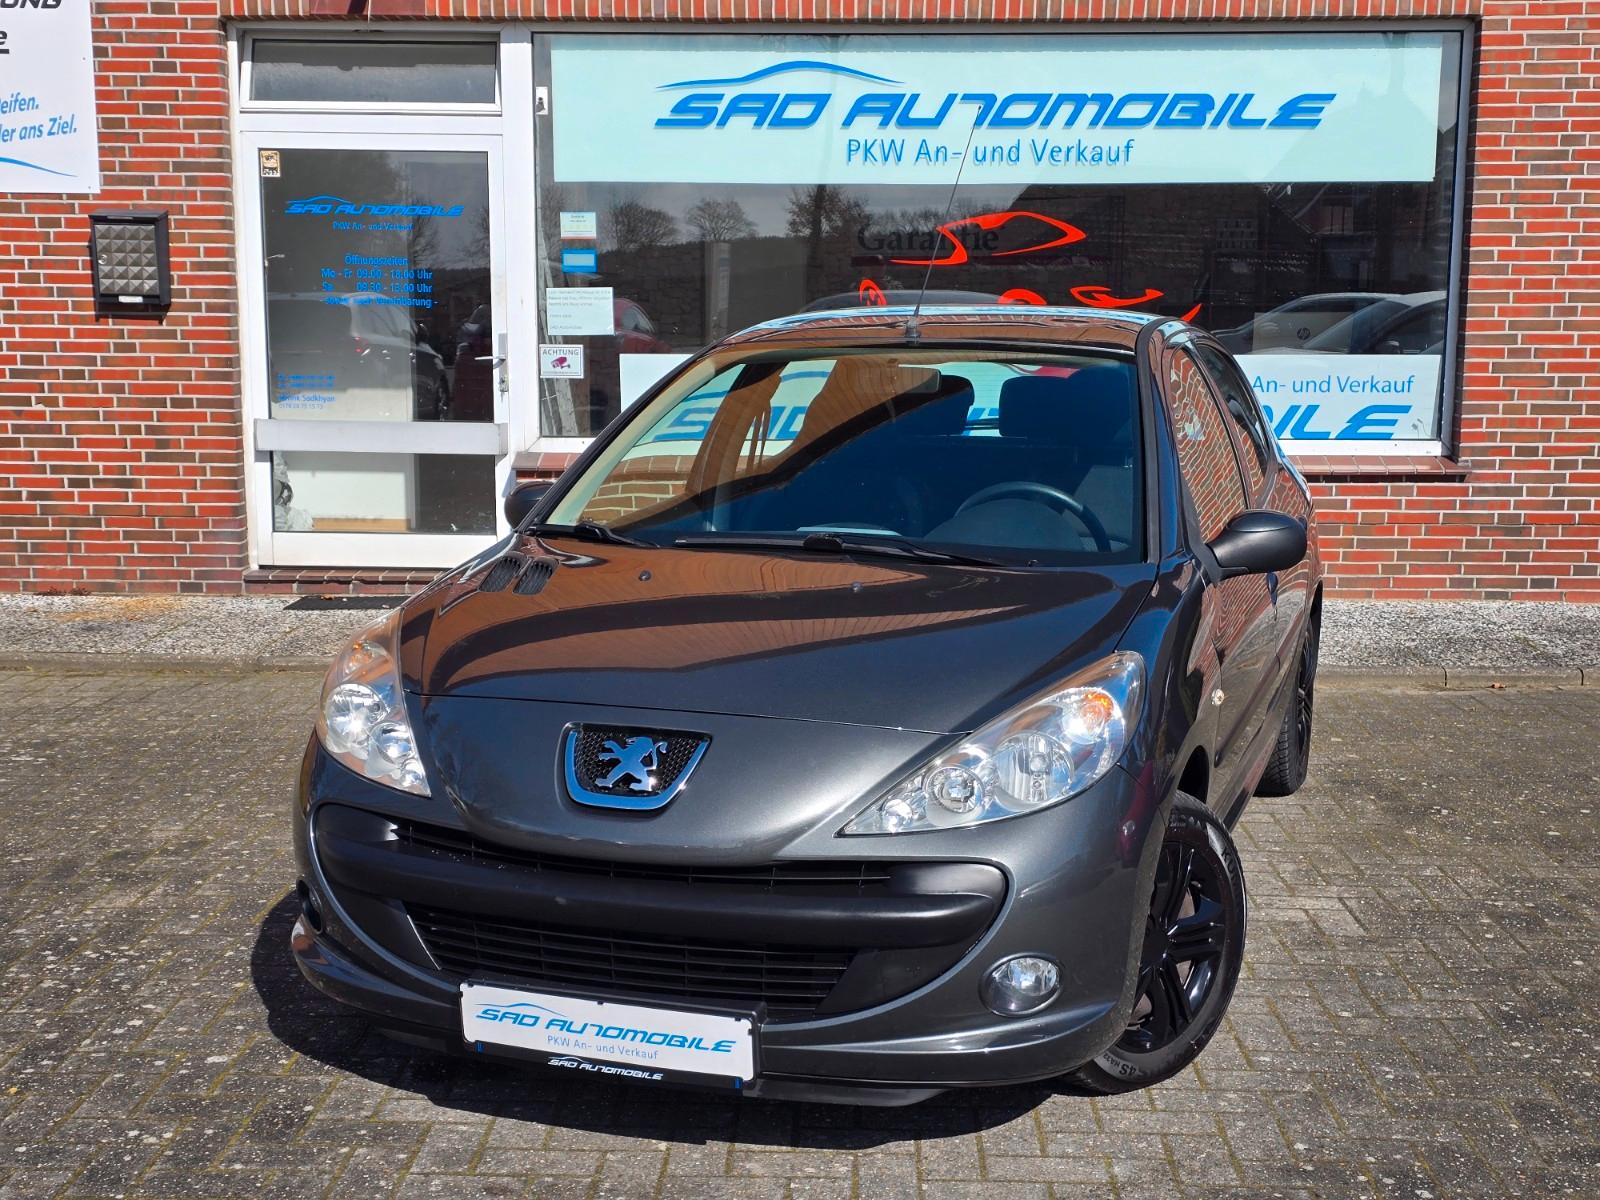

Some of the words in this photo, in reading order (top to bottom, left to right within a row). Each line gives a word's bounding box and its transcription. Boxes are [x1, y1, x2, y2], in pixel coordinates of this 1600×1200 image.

[0, 92, 40, 115] eifen.
[654, 93, 832, 130] SAD
[840, 93, 1338, 131] AUTOMOBILE
[19, 124, 44, 141] ans
[47, 114, 78, 137] Ziel.
[846, 138, 905, 166] PKW
[914, 138, 963, 164] An-
[972, 138, 1021, 166] und
[1030, 138, 1136, 167] Verkauf
[285, 203, 334, 216] SAD
[334, 204, 465, 217] AUTOMOBILE
[416, 268, 433, 280] Uhr
[416, 282, 433, 293] Uhr
[542, 348, 579, 356] ACHTUNG
[1252, 375, 1286, 393] An-
[1292, 375, 1331, 393] und
[1336, 374, 1416, 393] Verkauf
[476, 1008, 541, 1027] SAD
[545, 1020, 737, 1053] AUTOMOBILE
[546, 1035, 571, 1049] PKW
[573, 1037, 593, 1050] An-
[596, 1041, 616, 1054] und
[617, 1044, 659, 1060] Verkauf
[548, 1059, 578, 1068] SAD
[579, 1063, 663, 1080] AUTOMOBILE
